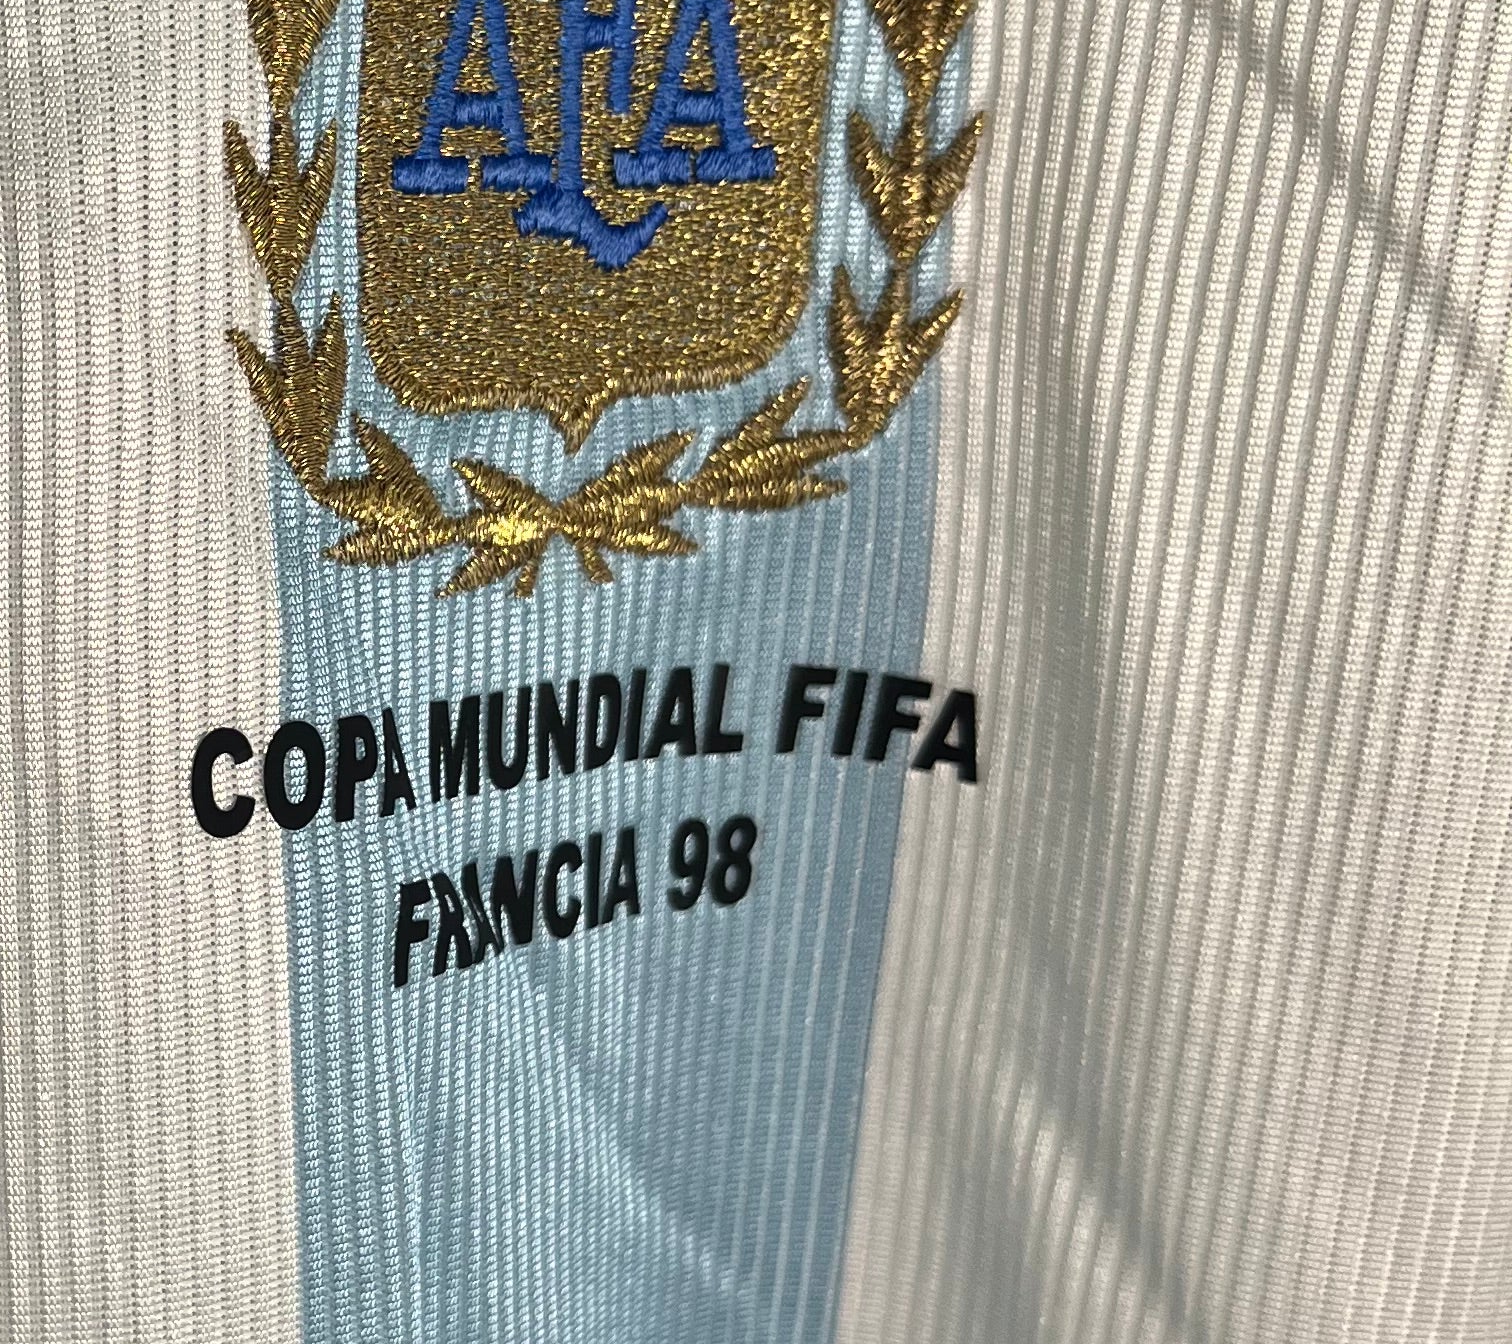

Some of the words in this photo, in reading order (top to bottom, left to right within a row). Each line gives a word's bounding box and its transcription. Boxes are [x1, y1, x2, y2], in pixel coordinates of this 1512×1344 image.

[191, 707, 418, 838] COPA
[428, 664, 744, 802] MUNDIAL
[776, 666, 980, 785] FIFA
[392, 824, 642, 988] FRANCIA
[667, 815, 759, 911] 98
